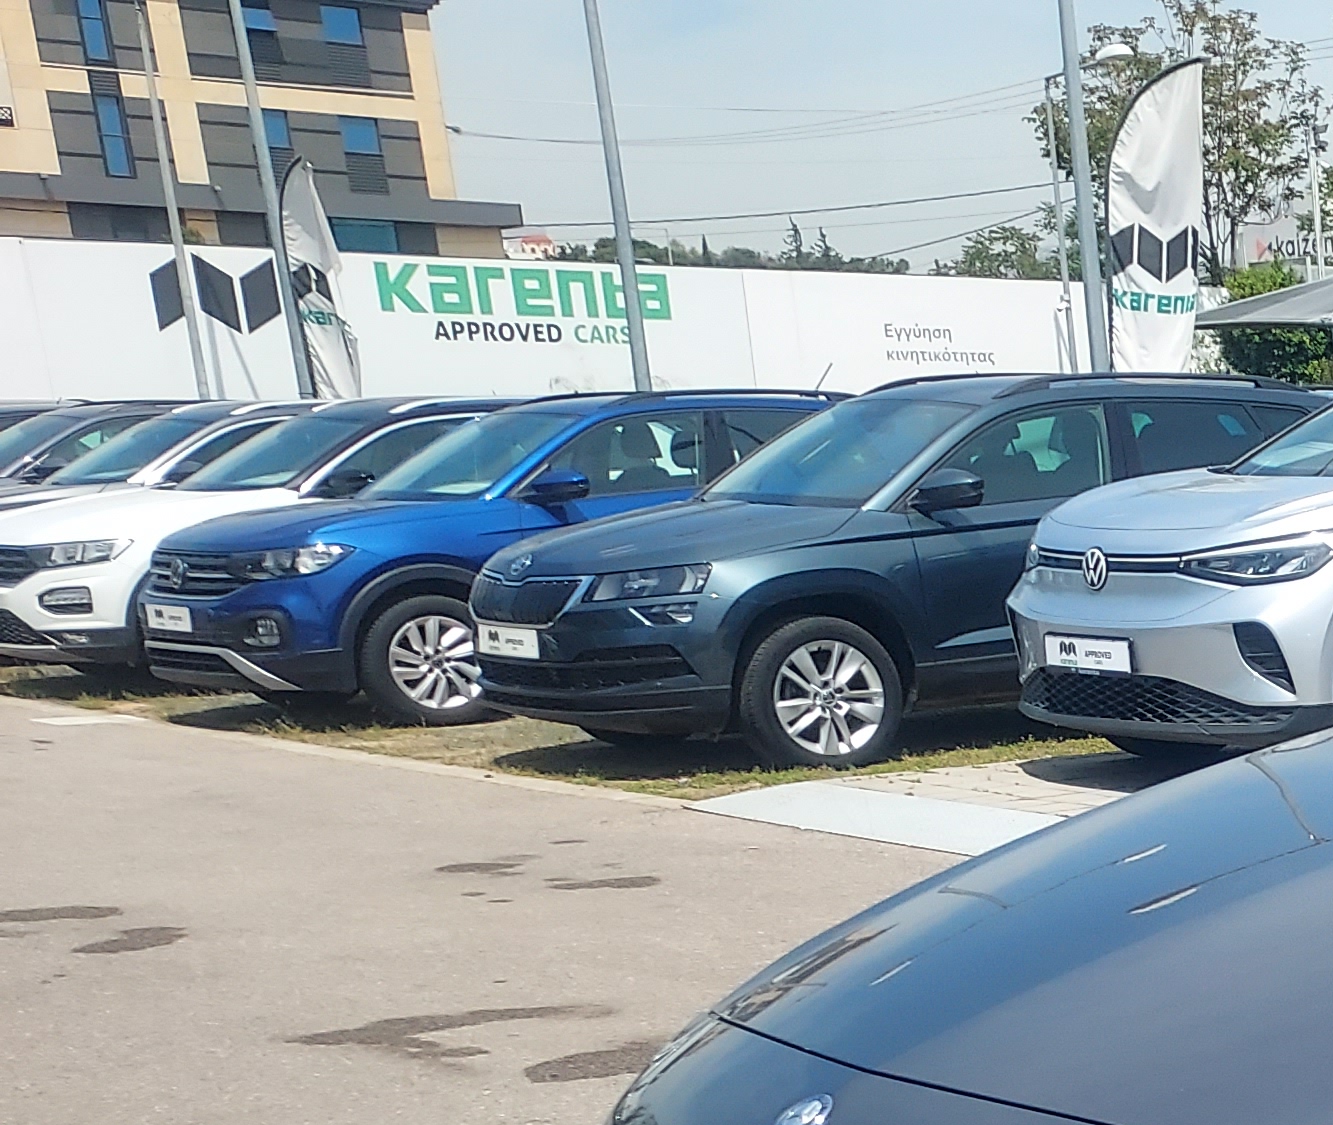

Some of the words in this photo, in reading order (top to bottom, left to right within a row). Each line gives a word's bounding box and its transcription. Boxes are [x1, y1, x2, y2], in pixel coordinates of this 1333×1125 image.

[434, 321, 562, 343] APPROVED
[574, 323, 630, 344] CARS
[884, 322, 953, 343] Εγγύηση
[886, 346, 996, 366] κινητικότητας
